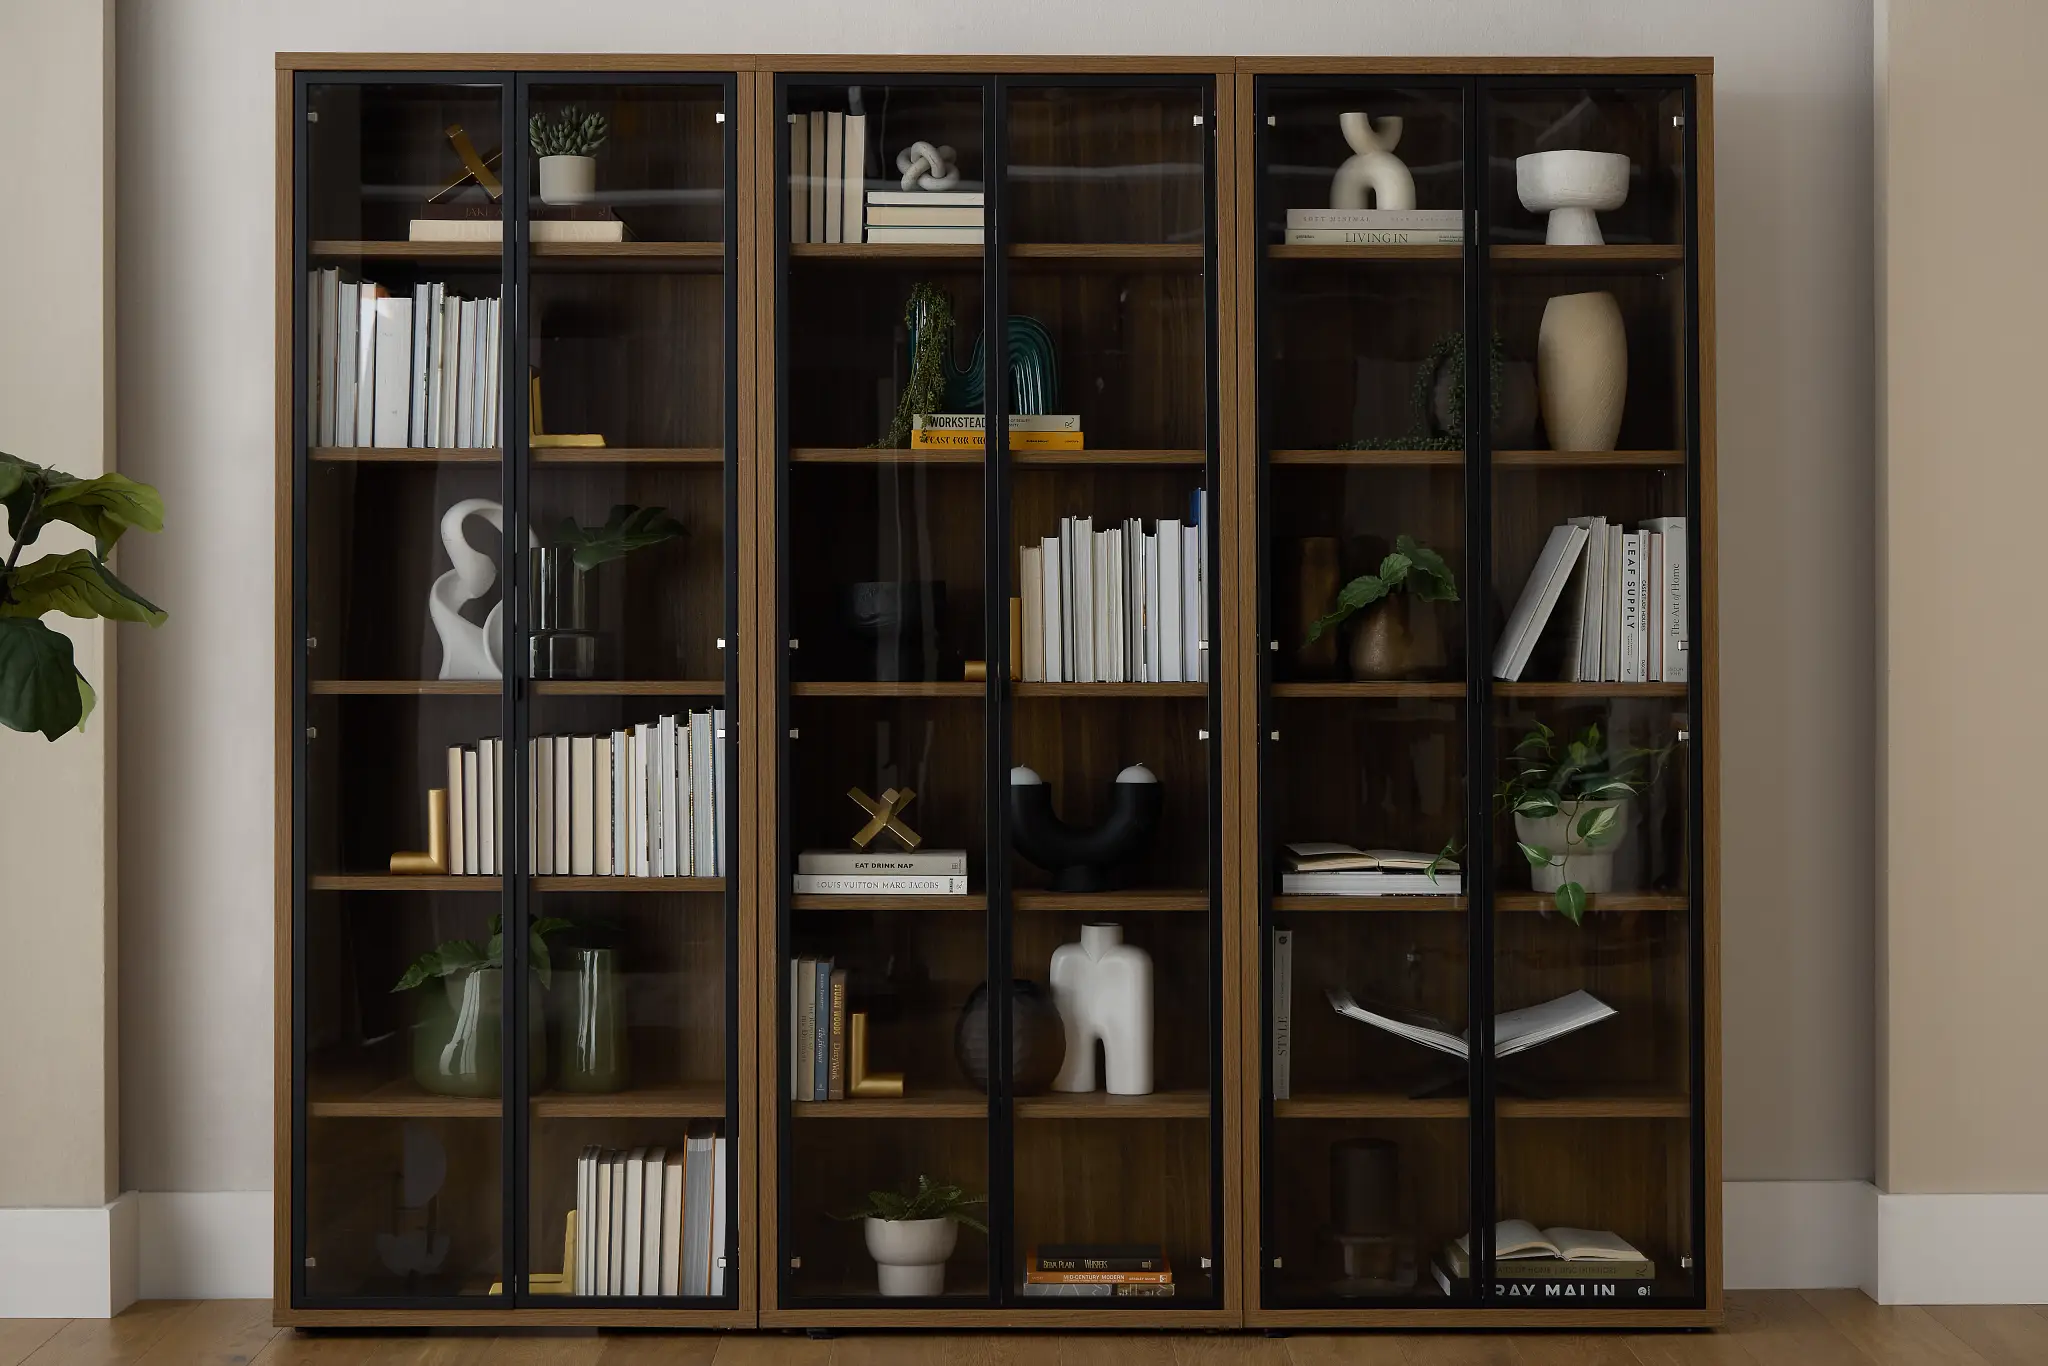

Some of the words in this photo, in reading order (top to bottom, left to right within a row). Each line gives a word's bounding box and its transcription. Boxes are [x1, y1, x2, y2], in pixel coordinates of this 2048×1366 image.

[1345, 232, 1391, 243] LIVING
[1393, 232, 1408, 243] IN
[931, 416, 985, 428] WORKSTEAD
[952, 436, 969, 444] FOR
[972, 436, 985, 444] TH
[1627, 541, 1636, 575] LEAF
[1671, 563, 1680, 592] Home
[1626, 581, 1636, 629] SUPPLY
[1671, 593, 1681, 602] of
[1671, 602, 1680, 618] Art
[1671, 619, 1680, 636] The
[816, 881, 841, 889] LOUIS
[844, 881, 879, 889] VUITTON
[882, 881, 906, 889] MARC
[908, 881, 939, 889] JACOBS
[834, 984, 842, 1008] STUART
[833, 1010, 842, 1035] WOODS
[1278, 1016, 1288, 1056] STYLE
[831, 1042, 841, 1062] Dirty
[831, 1061, 840, 1080] Work
[1495, 1284, 1535, 1296] RAY
